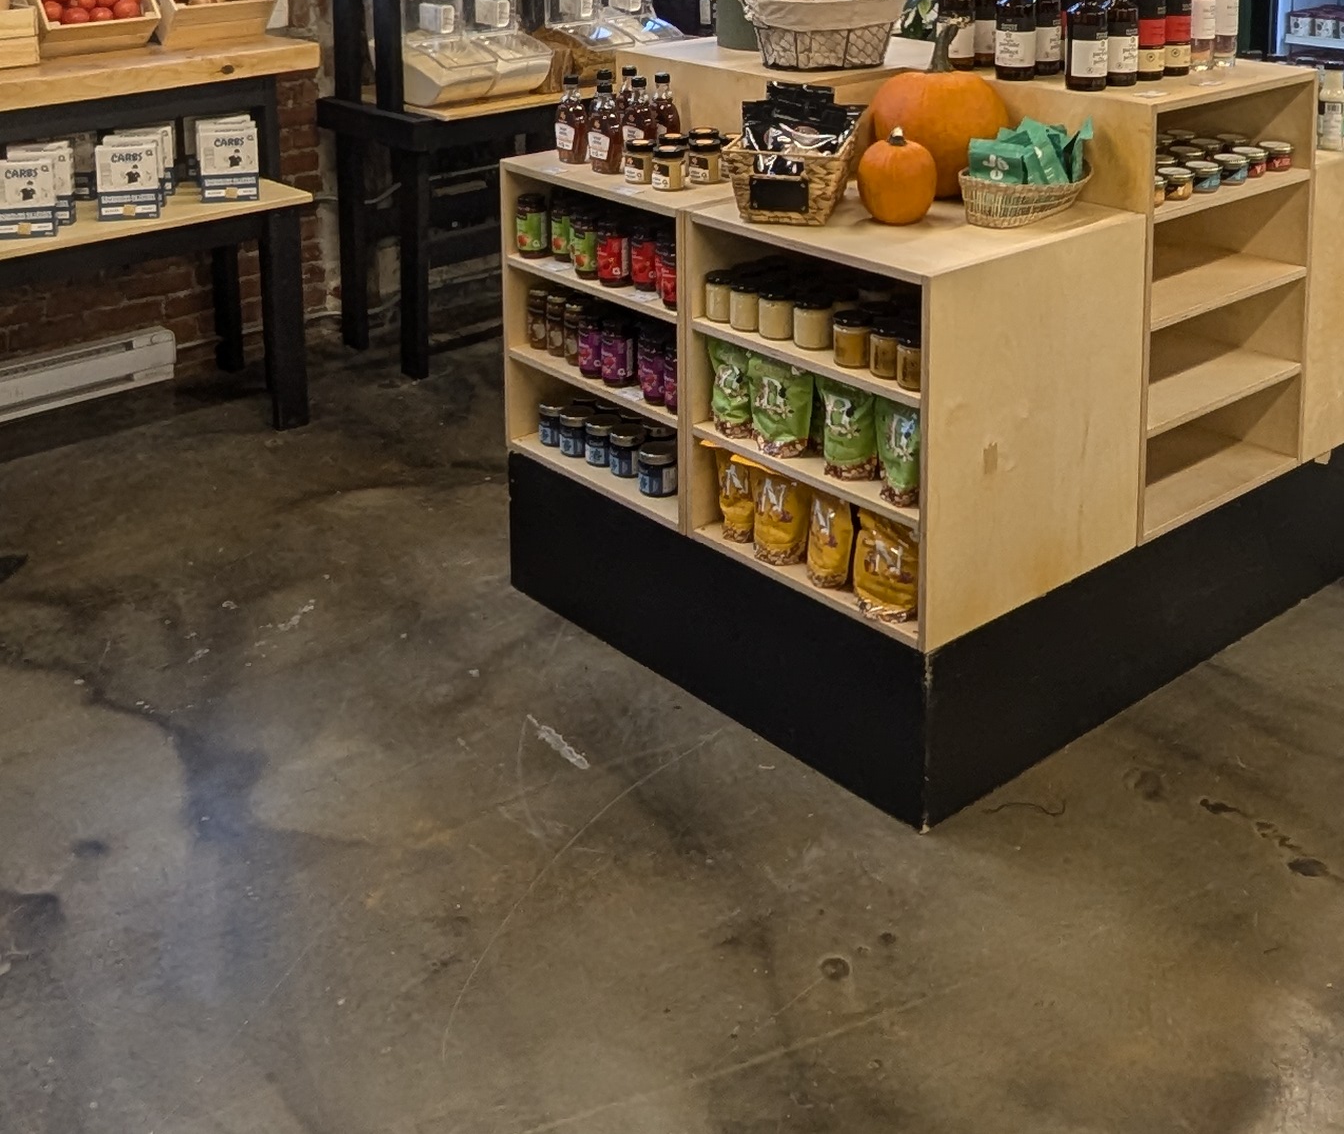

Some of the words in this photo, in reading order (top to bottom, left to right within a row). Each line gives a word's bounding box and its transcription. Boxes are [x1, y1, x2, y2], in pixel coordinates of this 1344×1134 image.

[214, 137, 245, 148] CARBS
[111, 151, 143, 163] CARBS
[4, 167, 39, 179] CARBS
